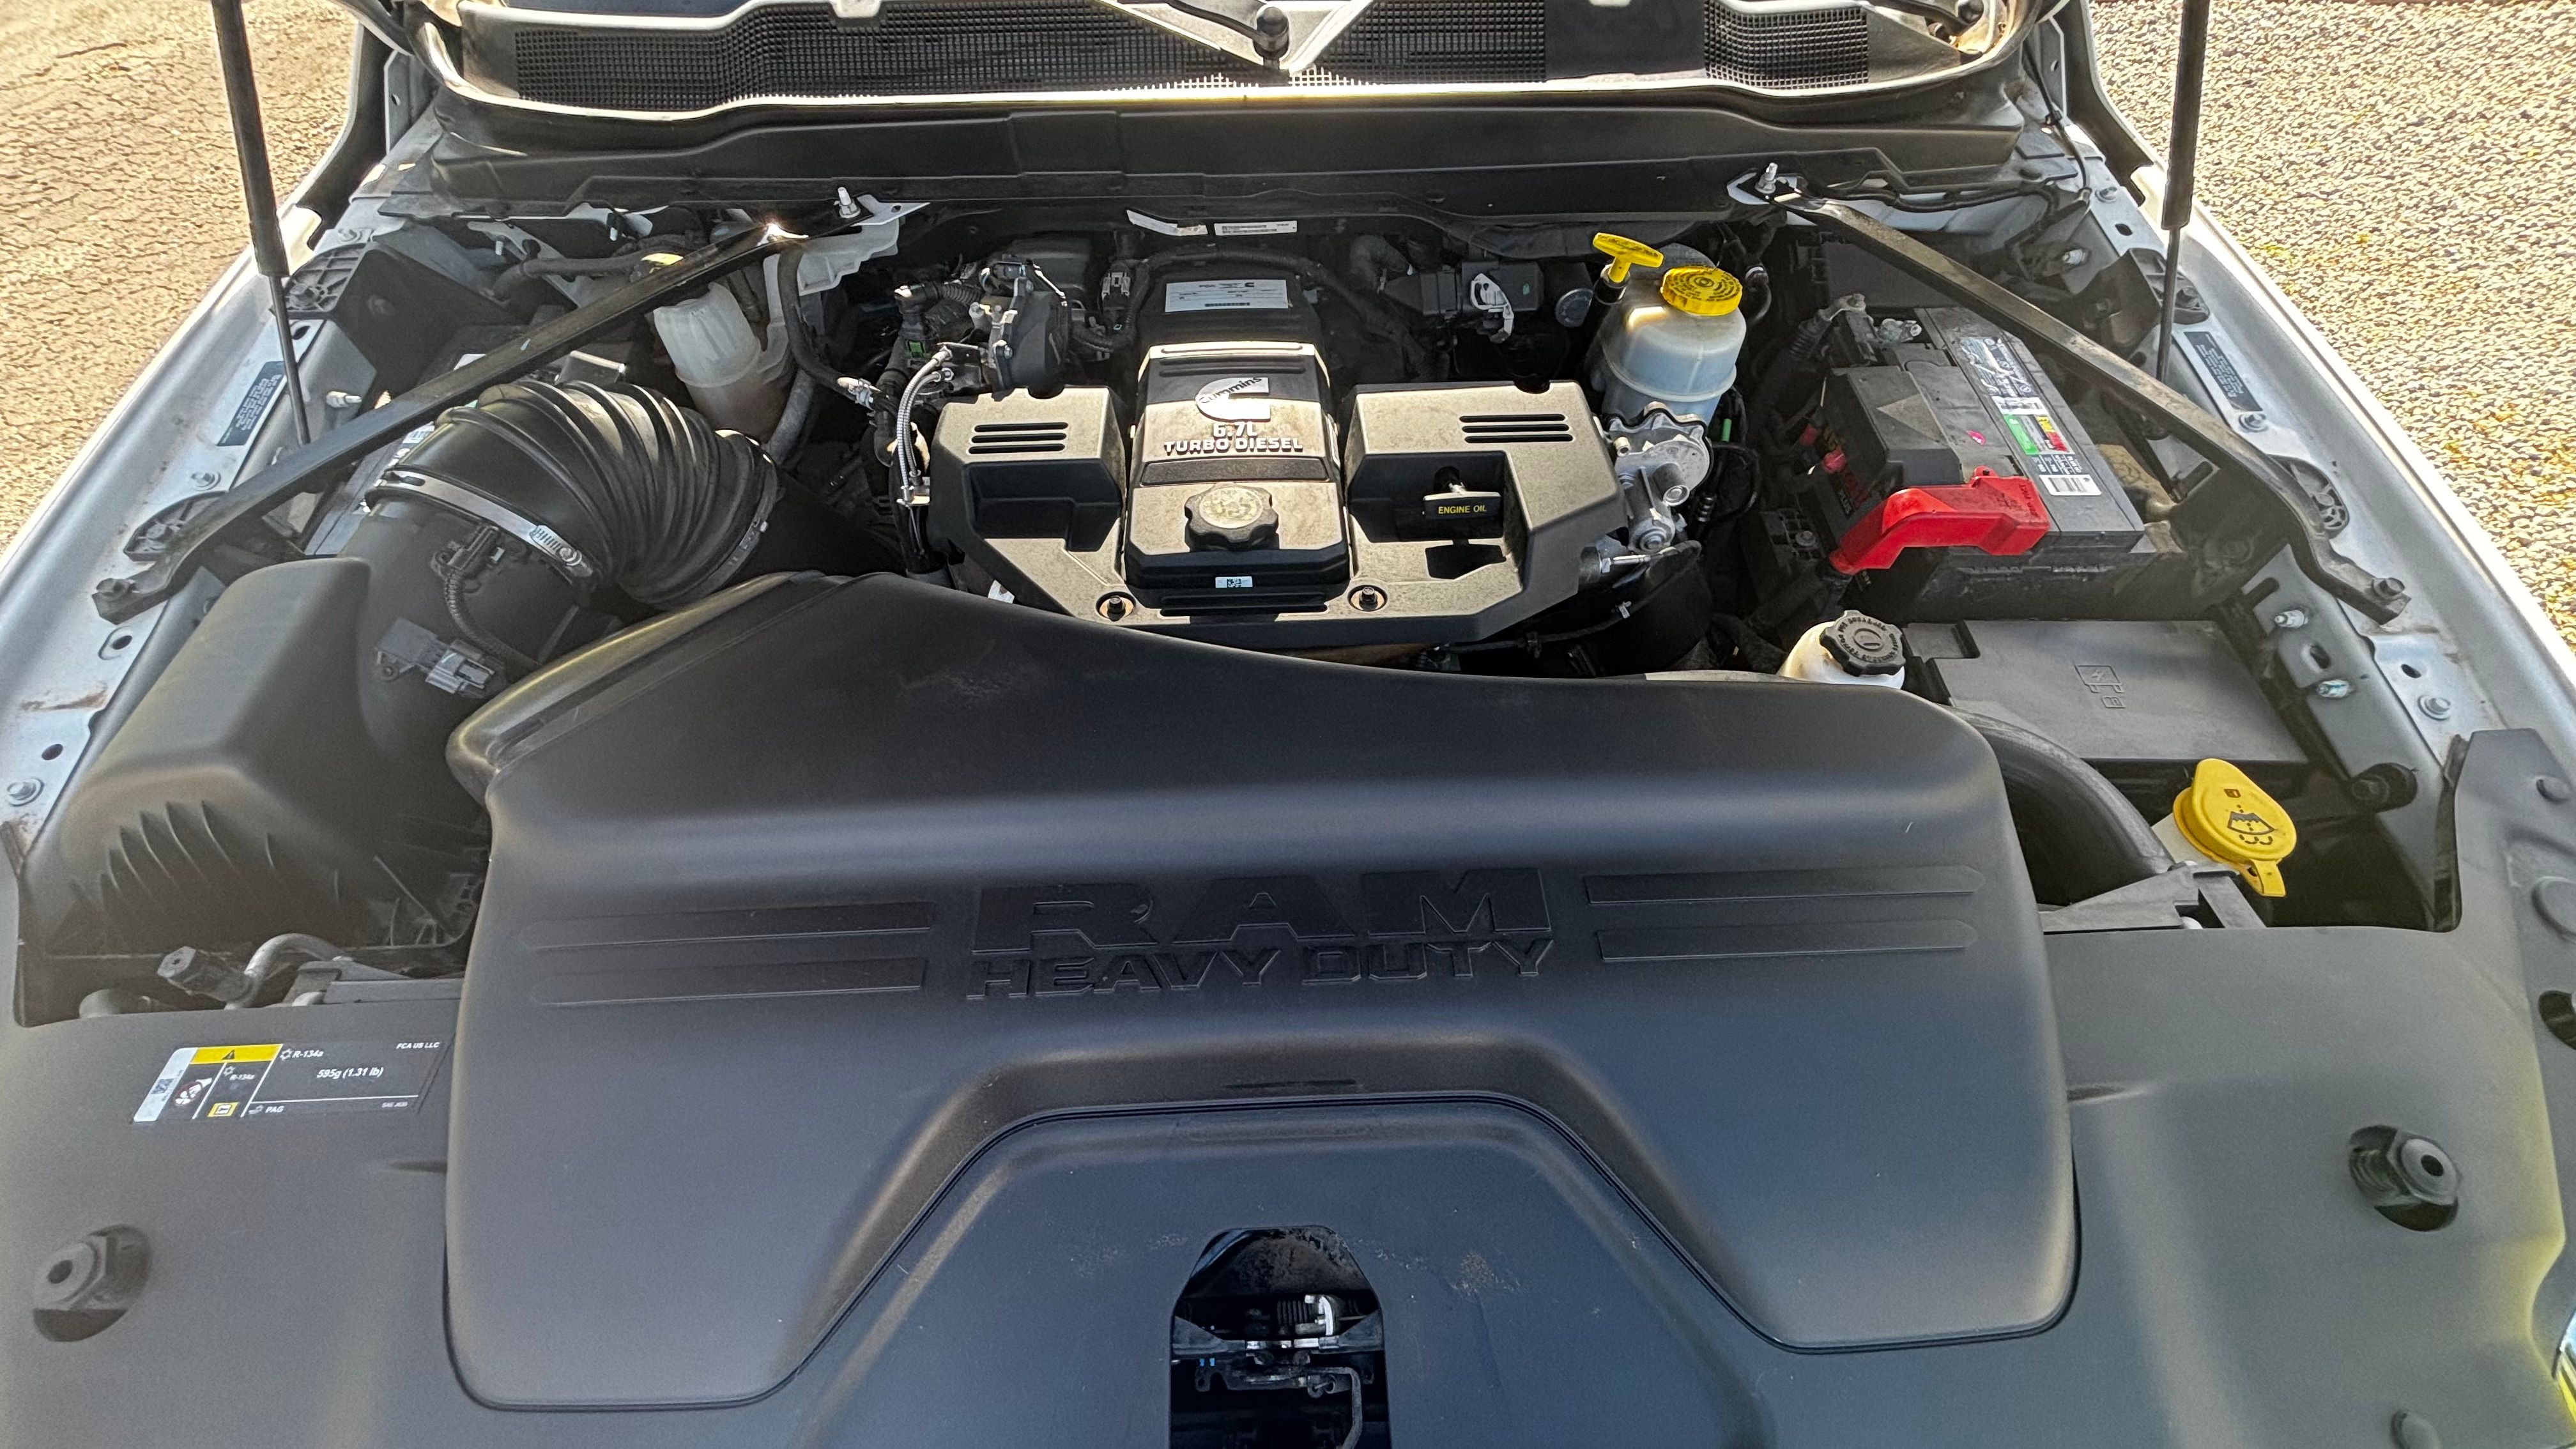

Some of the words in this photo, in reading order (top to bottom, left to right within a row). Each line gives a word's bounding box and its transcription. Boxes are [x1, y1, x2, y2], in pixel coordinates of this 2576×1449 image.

[1199, 376, 1262, 404] Cummins
[1213, 422, 1258, 439] 6.7L
[1164, 438, 1230, 456] TURBO
[1235, 437, 1303, 453] DIESEL
[1438, 505, 1470, 514] ENGINE
[1473, 505, 1487, 513] OIL
[971, 868, 1552, 954] RAM
[966, 948, 1281, 1000] HEAVY
[1301, 939, 1554, 985] DUTY
[292, 1050, 324, 1058] R-134a
[317, 1068, 341, 1079] 595g
[343, 1068, 368, 1078] (1.31
[369, 1066, 384, 1077] lb)
[265, 1105, 285, 1114] PAG
